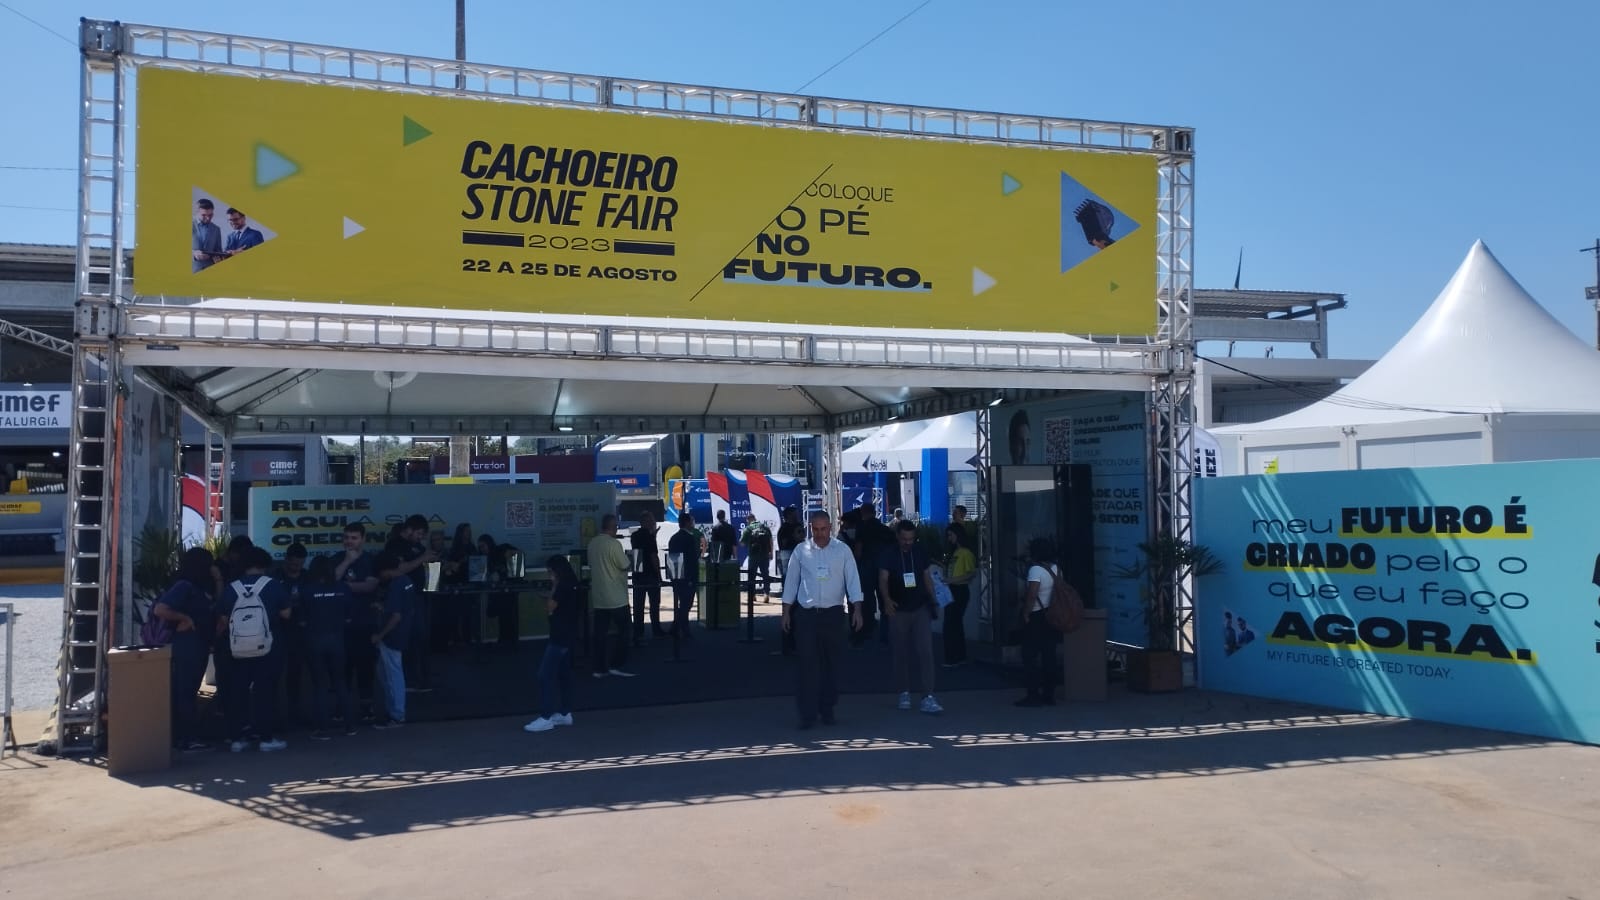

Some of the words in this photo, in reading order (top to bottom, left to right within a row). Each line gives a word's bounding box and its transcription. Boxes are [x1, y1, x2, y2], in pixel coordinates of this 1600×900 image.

[460, 140, 678, 192] CACHOEIRO
[804, 183, 894, 202] COLOQUE
[461, 183, 587, 226] STONE
[597, 192, 678, 232] FAIR
[776, 206, 806, 231] O
[820, 204, 870, 236] PÉ
[528, 235, 610, 252] 2023
[756, 233, 810, 256] NO
[462, 259, 491, 272] 22
[497, 261, 515, 274] A
[521, 262, 549, 275] 25
[554, 264, 581, 277] DE
[587, 266, 677, 282] AGOSTO
[723, 257, 933, 289] FUTURO.
[270, 461, 298, 470] cimef
[1113, 488, 1140, 498] QUE
[271, 499, 370, 512] RETIRE
[1252, 518, 1333, 534] meu
[1341, 505, 1493, 534] FUTURO
[1504, 496, 1527, 534] É
[272, 516, 347, 529] AQUI
[357, 514, 374, 527] A
[1099, 513, 1139, 525] SETOR
[1246, 543, 1376, 570] CRIADO
[1386, 550, 1480, 575] pelo
[1498, 556, 1528, 574] o
[1267, 581, 1340, 601] que
[1353, 585, 1405, 603] eu
[1419, 582, 1529, 614] faço
[1271, 611, 1532, 661] AGORA.
[1267, 650, 1283, 661] MY
[1286, 651, 1330, 666] FUTURE
[1333, 656, 1344, 668] IS
[1347, 658, 1403, 674] CREATED
